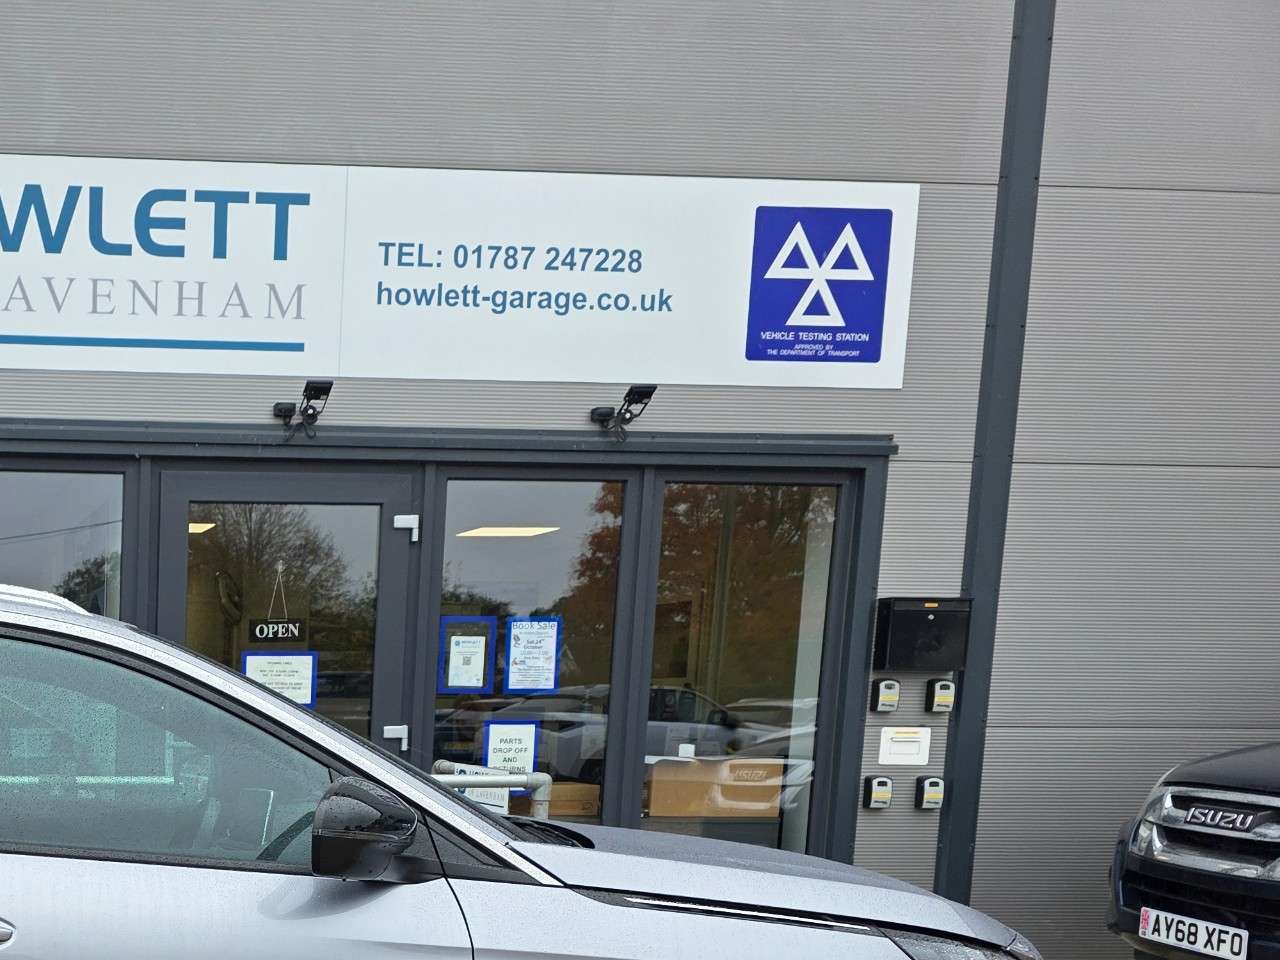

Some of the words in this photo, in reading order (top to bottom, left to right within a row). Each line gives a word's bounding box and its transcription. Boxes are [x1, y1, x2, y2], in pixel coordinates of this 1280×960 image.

[379, 242, 442, 267] TEL:
[454, 245, 535, 270] 01787
[545, 247, 642, 273] 247228
[376, 281, 673, 315] howlett-garage.co.uk
[761, 331, 795, 340] VEHICLE
[798, 332, 832, 341] TESTING
[836, 333, 869, 341] STATION
[255, 623, 299, 638] OPEN
[1185, 807, 1254, 829] ISUZU
[1151, 914, 1198, 946] AY68
[1203, 926, 1243, 956] XFO
